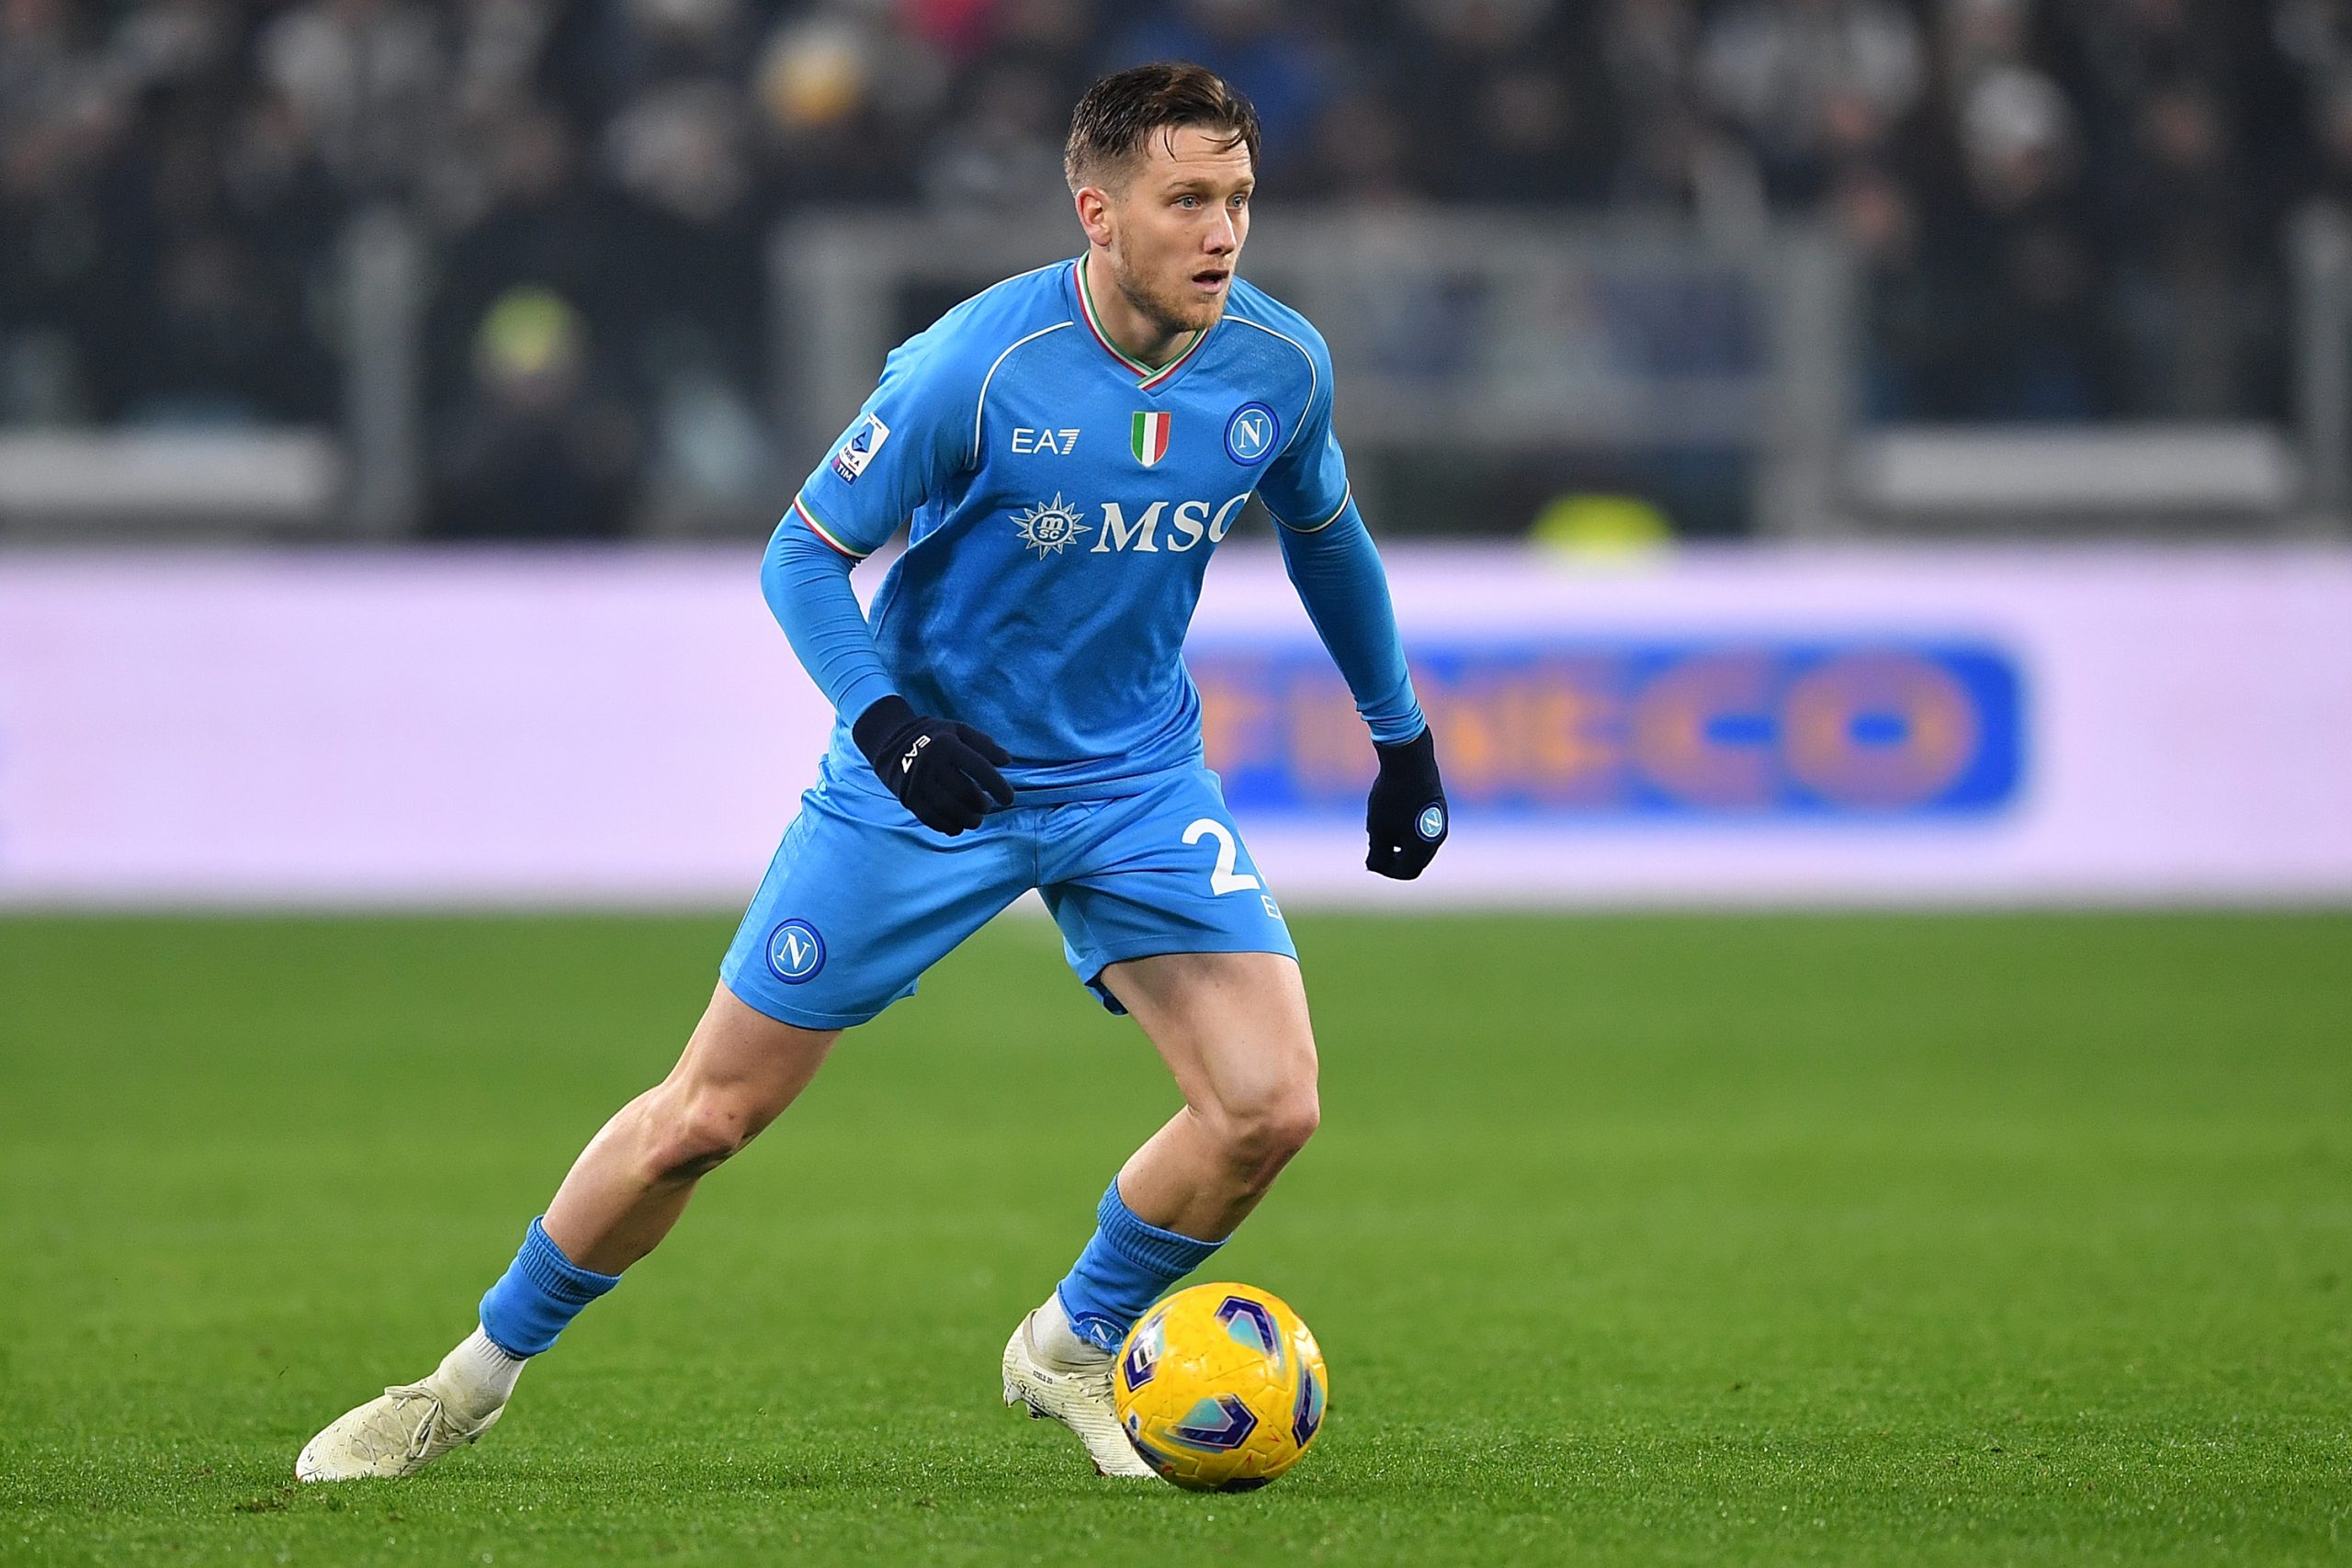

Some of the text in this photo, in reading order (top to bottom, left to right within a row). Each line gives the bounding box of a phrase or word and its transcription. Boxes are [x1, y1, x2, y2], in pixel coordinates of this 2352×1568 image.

[1012, 428, 1080, 455] EA7
[1238, 419, 1262, 448] N
[837, 463, 854, 482] TIM
[901, 735, 932, 773] EA7
[776, 932, 811, 970] N
